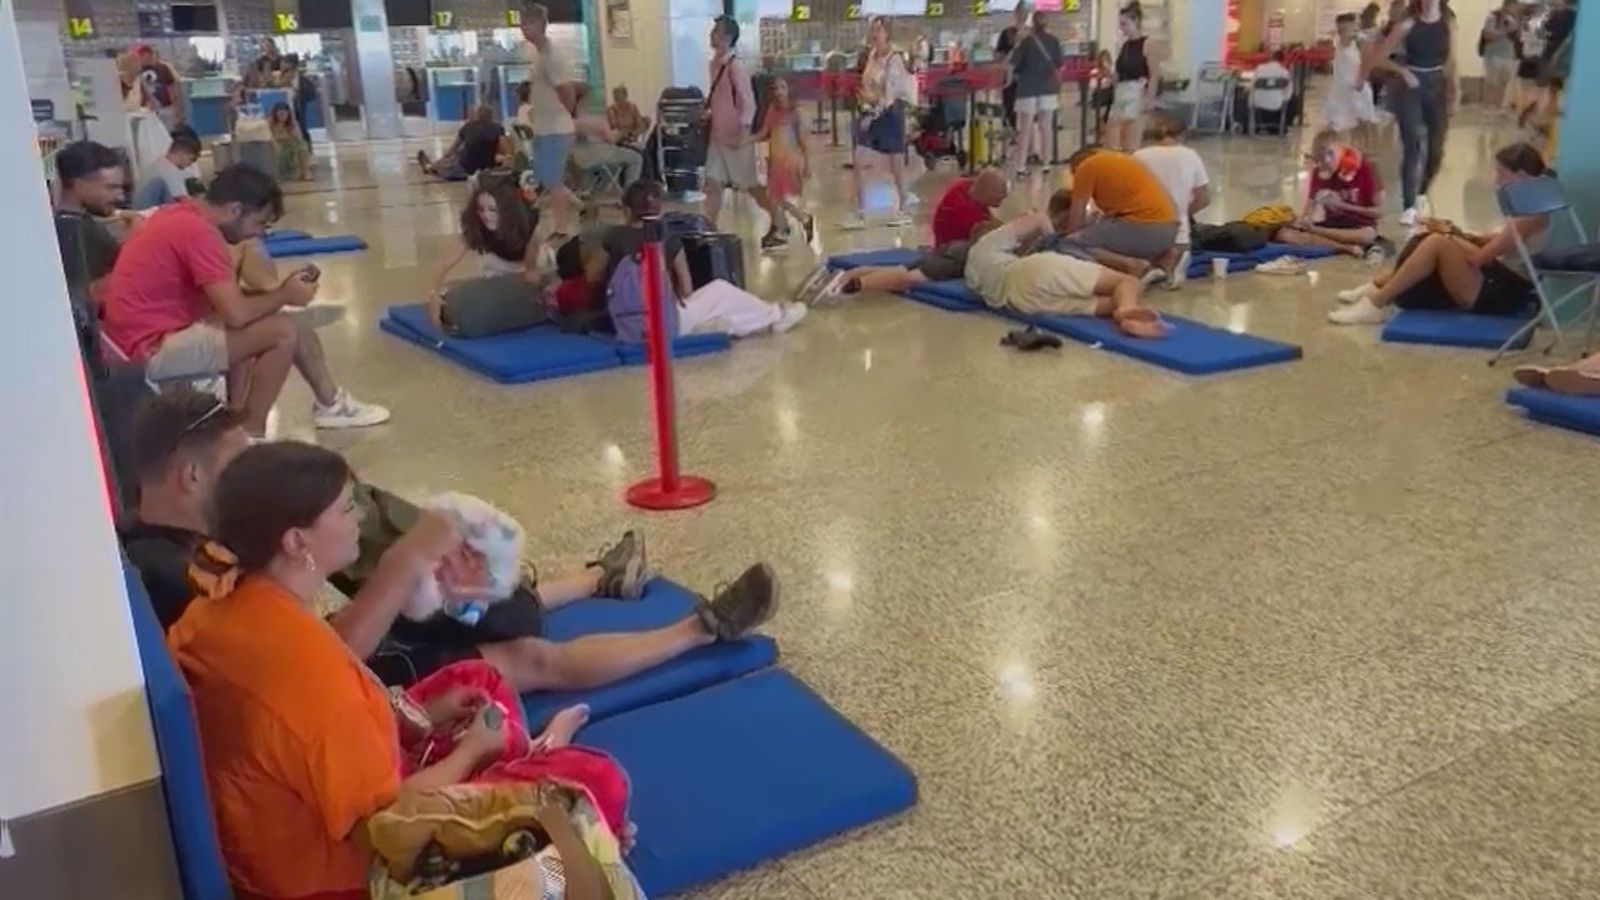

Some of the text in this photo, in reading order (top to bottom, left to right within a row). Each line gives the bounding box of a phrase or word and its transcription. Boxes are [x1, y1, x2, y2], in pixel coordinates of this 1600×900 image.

[70, 17, 94, 35] 14
[275, 13, 299, 30] 16
[436, 11, 453, 26] 17
